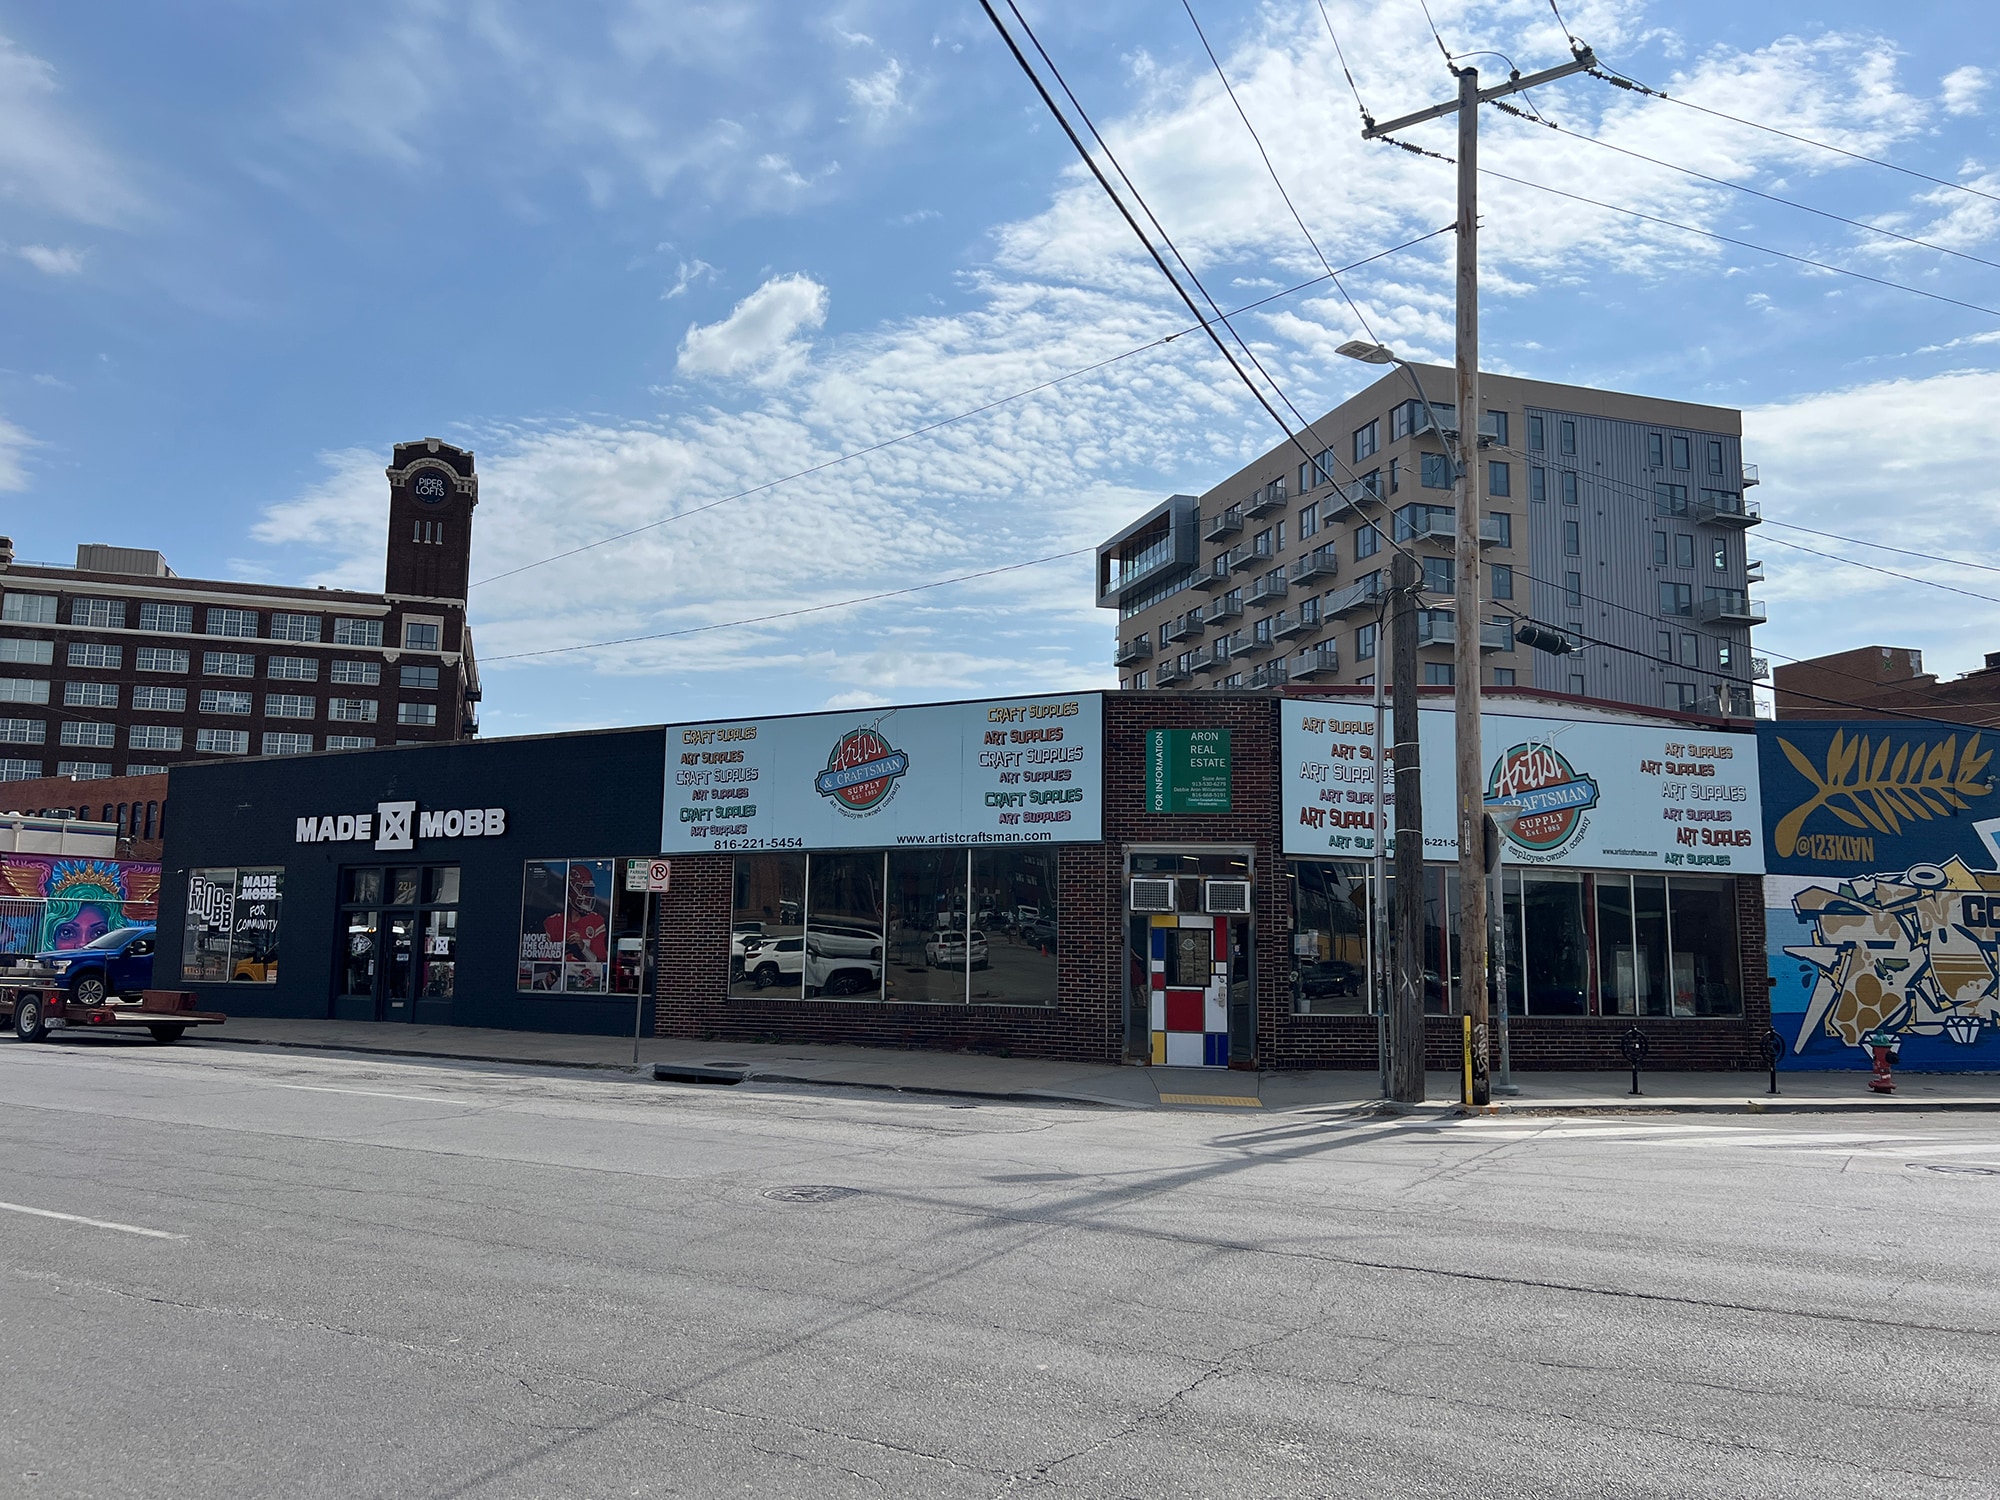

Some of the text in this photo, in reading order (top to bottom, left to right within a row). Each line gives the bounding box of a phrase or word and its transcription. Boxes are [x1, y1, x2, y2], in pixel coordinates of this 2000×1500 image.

[419, 478, 443, 488] PIPER
[416, 486, 445, 497] LOFTS
[987, 706, 1027, 723] CRAFT
[1302, 717, 1375, 735] ART SUPPLIE
[682, 729, 715, 745] CRAFT
[831, 710, 896, 772] Artist
[983, 730, 1007, 745] ART
[1190, 732, 1219, 741] ARON
[1190, 745, 1216, 754] REAL
[1331, 743, 1356, 760] ART
[1664, 742, 1685, 758] ART
[681, 752, 700, 766] ART
[978, 750, 1023, 769] CRAFT
[1190, 758, 1226, 768] ESTATE
[1494, 723, 1575, 798] Artist
[824, 759, 900, 788] & CRAFTSMAN
[1155, 731, 1163, 811] FOR INFORMATION
[1300, 762, 1329, 783] ART
[1640, 760, 1662, 775] ART
[676, 770, 712, 786] CRAFT
[999, 771, 1021, 784] ART
[692, 789, 709, 801] ART
[847, 780, 880, 796] SUPPLY
[1662, 782, 1687, 801] ART
[984, 791, 1027, 808] CRAFT
[1319, 789, 1343, 804] ART
[680, 807, 713, 822] CRAFT
[999, 812, 1021, 825] ART
[1300, 807, 1326, 829] ART
[1519, 813, 1564, 830] SUPPLY
[1662, 808, 1684, 823] ART
[296, 814, 372, 843] MADE
[419, 808, 505, 838] MOBB
[690, 825, 709, 837] ART
[1525, 824, 1561, 837] Est. 1985
[714, 837, 803, 849] 816-221-5454
[896, 832, 1052, 844] www.artistcraftsman.com
[1328, 835, 1352, 850] ART
[1508, 816, 1591, 863] employee-owned company
[1676, 827, 1699, 847] ART
[1664, 852, 1684, 866] ART
[243, 875, 277, 888] MADE
[398, 882, 412, 891] 221
[249, 904, 266, 917] FOR
[236, 919, 278, 932] COMMUNITY
[523, 933, 547, 942] MOVE
[522, 942, 562, 950] THE GAME
[521, 950, 562, 958] FORWARD
